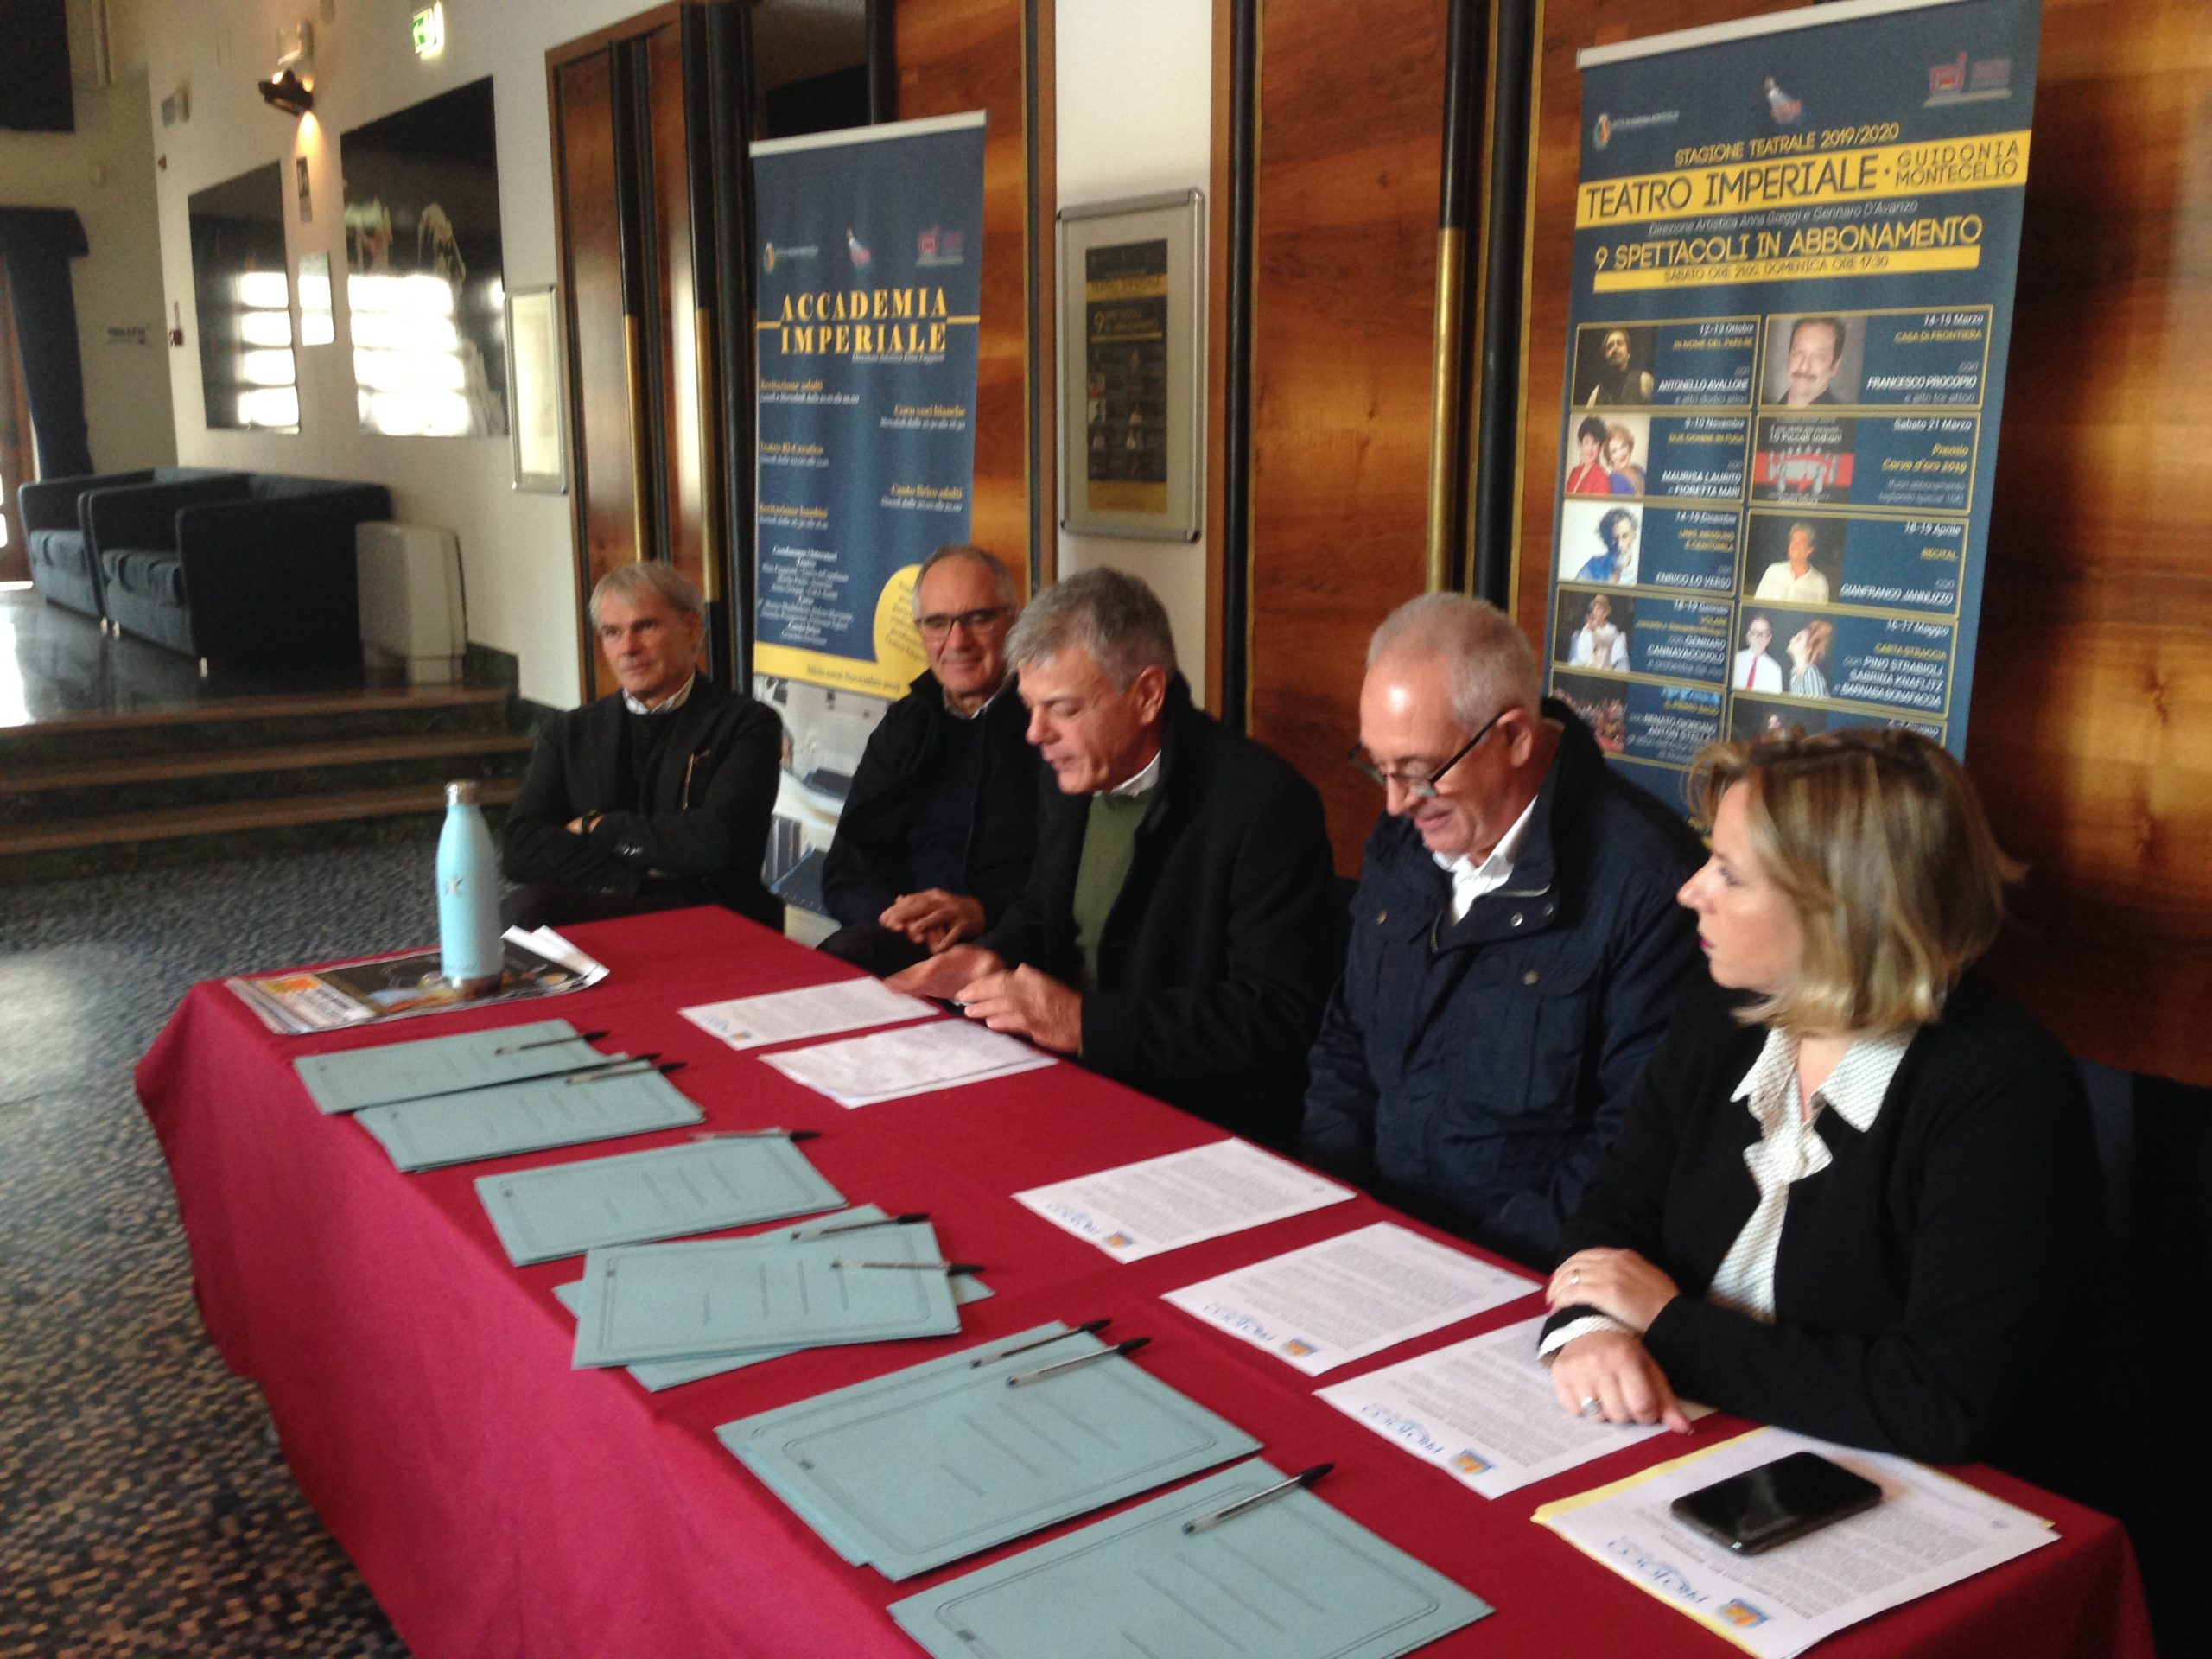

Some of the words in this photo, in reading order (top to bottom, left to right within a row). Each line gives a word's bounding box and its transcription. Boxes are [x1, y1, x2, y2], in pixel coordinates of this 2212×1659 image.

[1675, 141, 1745, 167] STAGIONE
[1749, 131, 1816, 157] TEATRALE
[1820, 122, 1900, 149] 2019/2020
[1897, 139, 2020, 168] GUIDONIA
[1895, 159, 2018, 188] MONTECELIO
[1586, 175, 1693, 219] TEATRO
[1703, 154, 1879, 207] IMPERIALE
[1648, 219, 1694, 237] Direzione
[1694, 216, 1738, 232] Artistica
[1814, 204, 1864, 221] Gennaro
[1595, 245, 1609, 271] 9
[1614, 233, 1751, 270] SPETTACOLI
[1753, 229, 1783, 260] IN
[1786, 213, 1984, 258] ABBONAMENTO
[780, 286, 948, 323] ACCADEMIA
[1953, 313, 1984, 327] Marzo
[780, 322, 946, 355] IMPERIALE
[1866, 374, 1926, 391] FRANCESCO
[1924, 374, 1978, 390] PROCOPIO
[1892, 416, 1928, 432] Sabato
[1941, 418, 1973, 432] Marzo
[1931, 442, 1970, 457] Premio
[1932, 523, 1962, 539] Aprile
[1839, 582, 1903, 602] GIANFRANCO
[1901, 588, 1954, 607] JANNUZZO
[1912, 621, 1950, 639] Maggio
[1862, 655, 1890, 671] PINO
[1848, 668, 1894, 687] SABRINA
